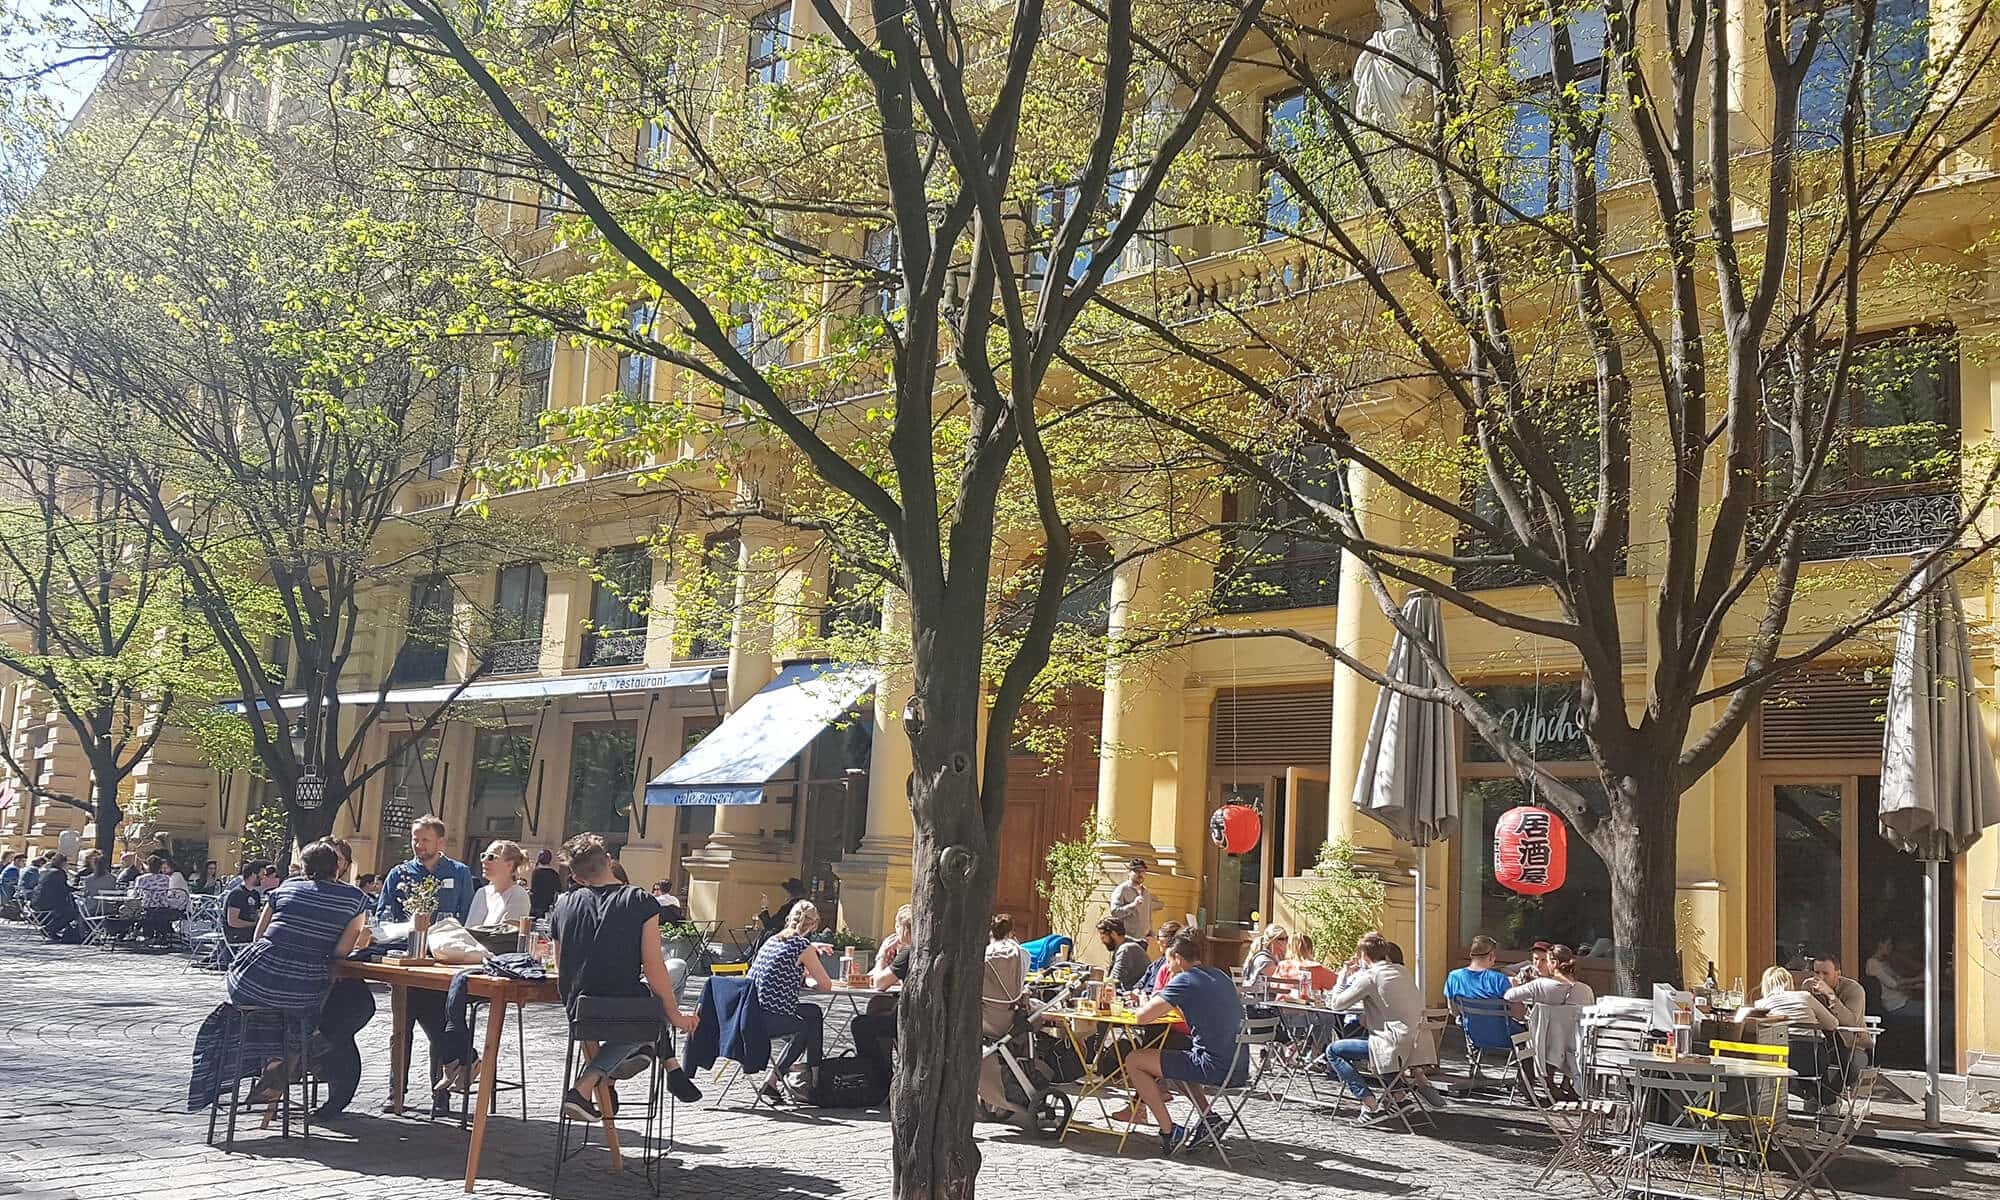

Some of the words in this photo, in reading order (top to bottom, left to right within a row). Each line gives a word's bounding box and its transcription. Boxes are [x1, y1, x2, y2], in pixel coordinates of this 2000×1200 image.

[614, 676, 667, 689] restaurant
[1516, 812, 1551, 885] 居酒屋
